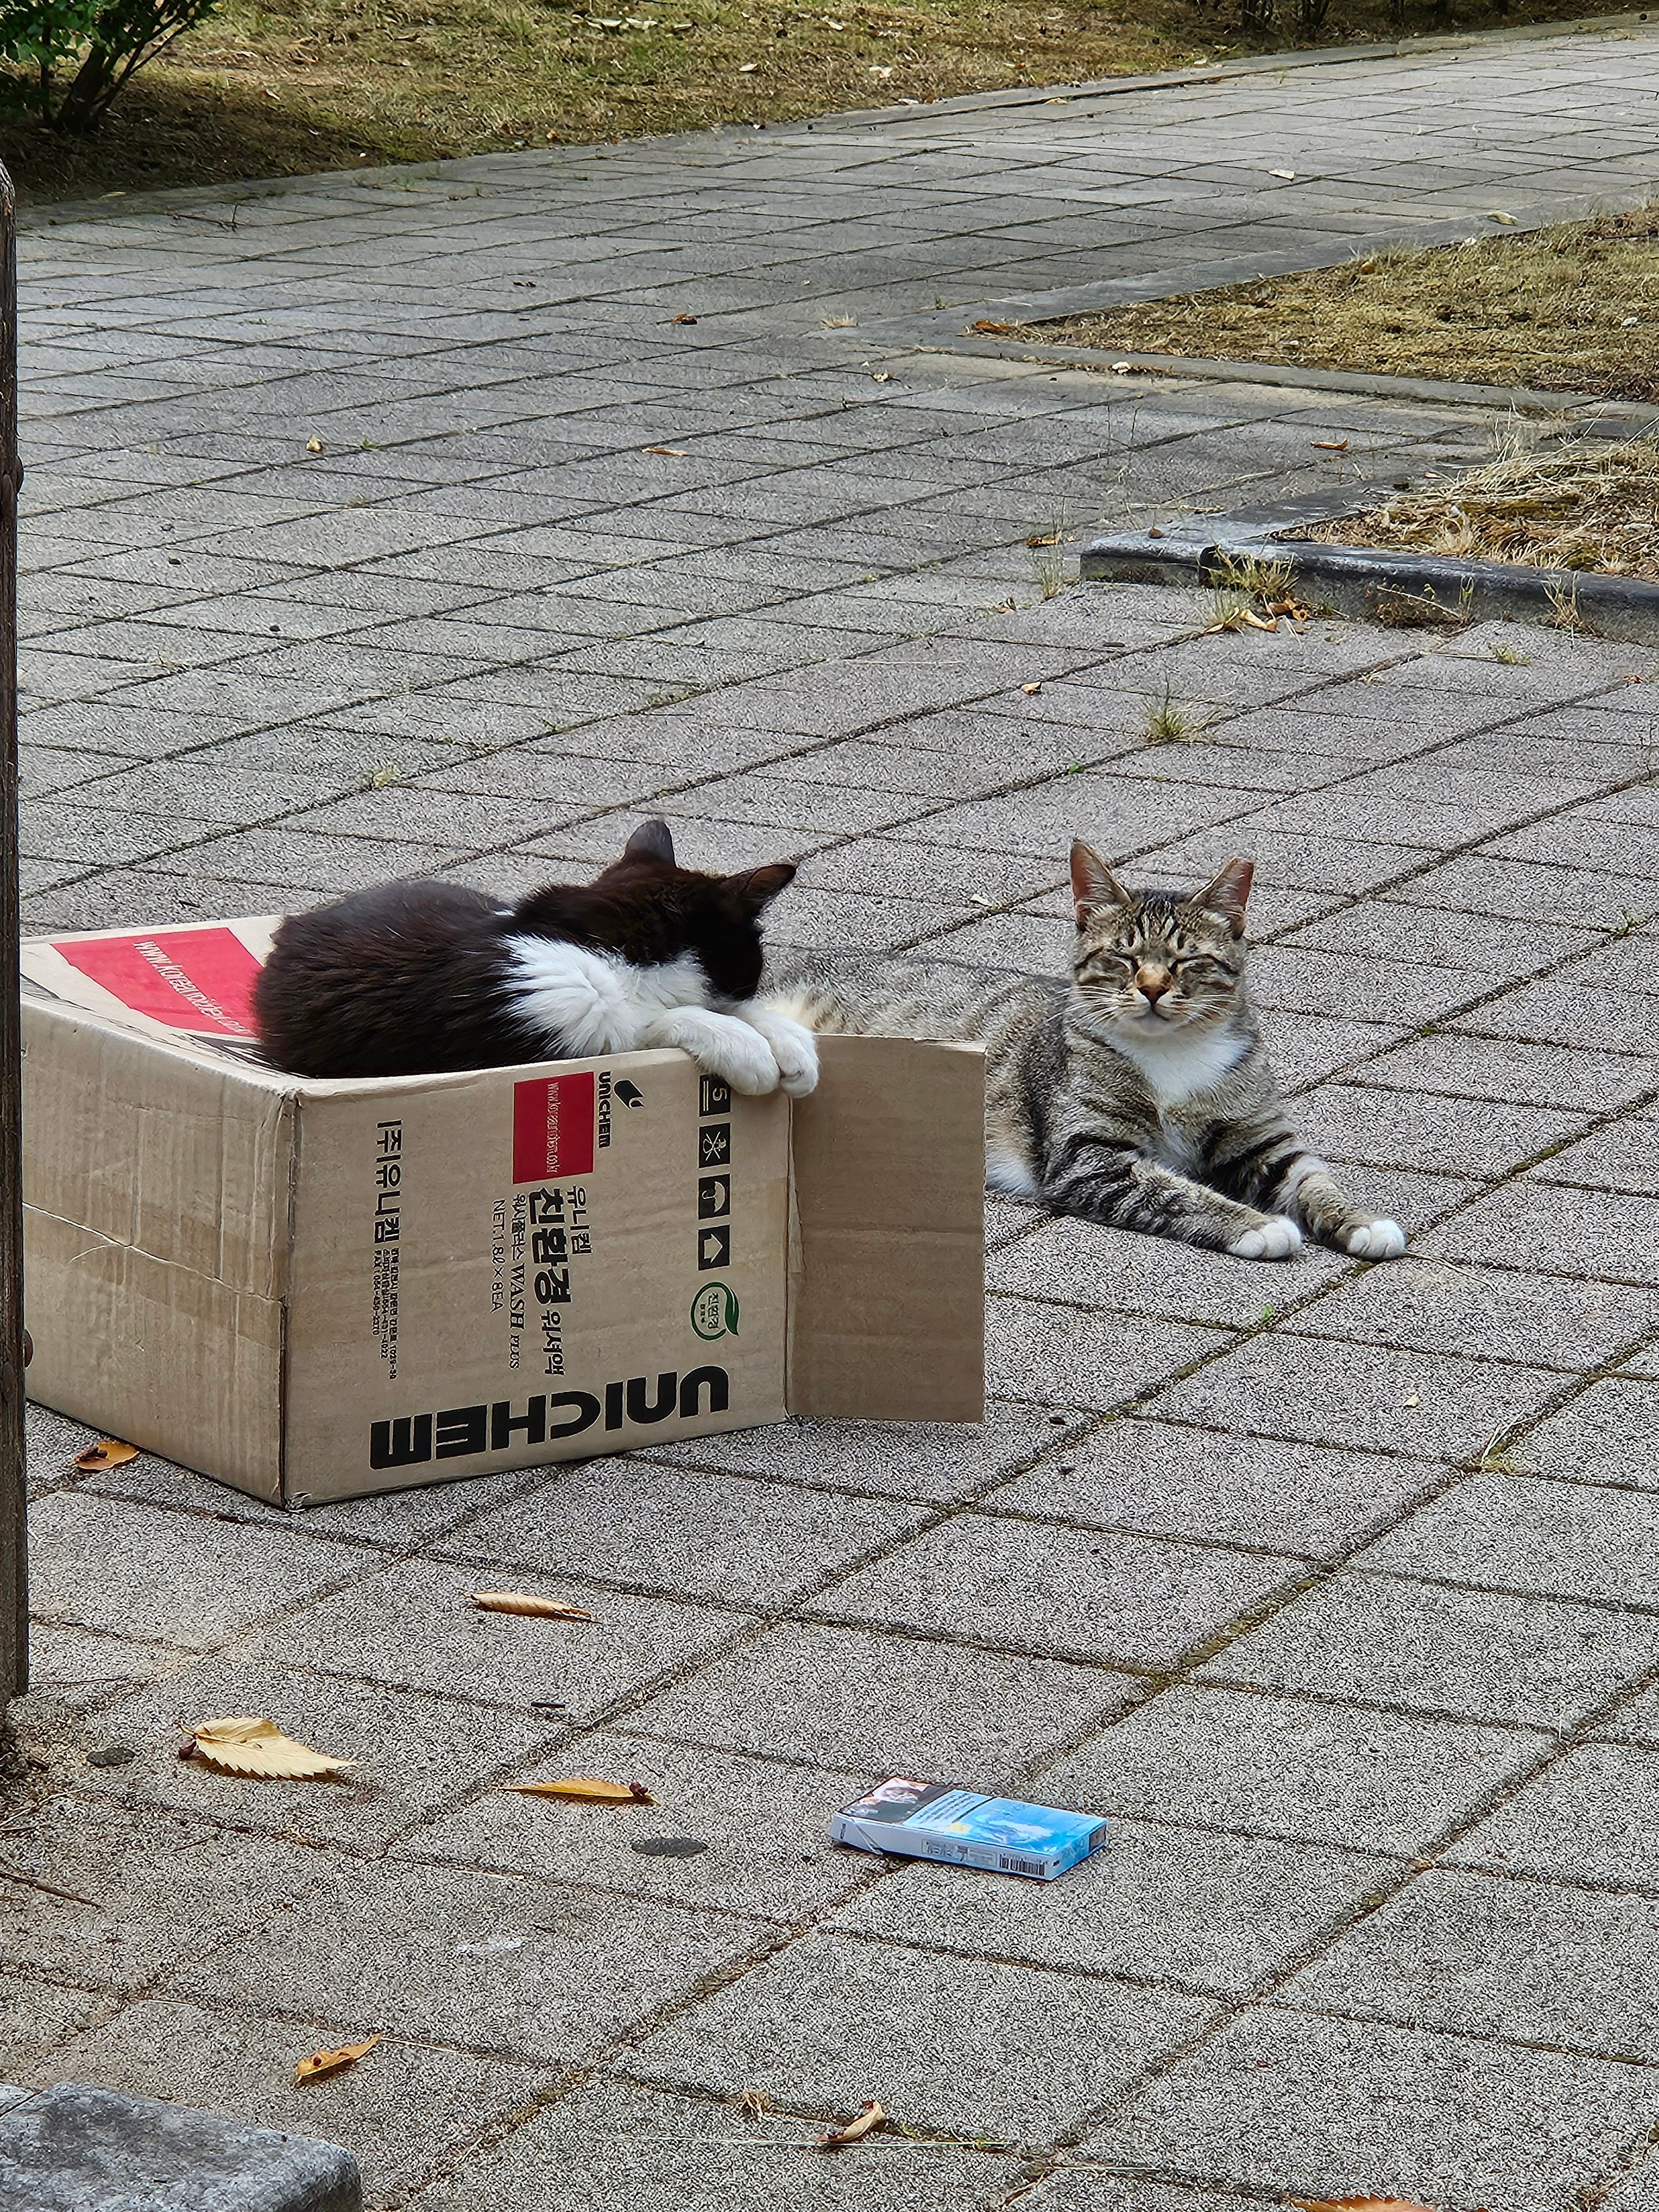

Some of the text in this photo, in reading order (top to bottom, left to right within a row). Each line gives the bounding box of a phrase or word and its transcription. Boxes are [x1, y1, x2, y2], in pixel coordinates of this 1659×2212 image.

[598, 1071, 611, 1149] UNICHEM
[712, 1088, 727, 1101] 5
[566, 1186, 591, 1255] 유니켐
[509, 1263, 524, 1329] WASH
[528, 1188, 571, 1376] 친환경 워셔액
[508, 1333, 519, 1370] PLUS
[369, 1365, 728, 1470] UNICHEM
